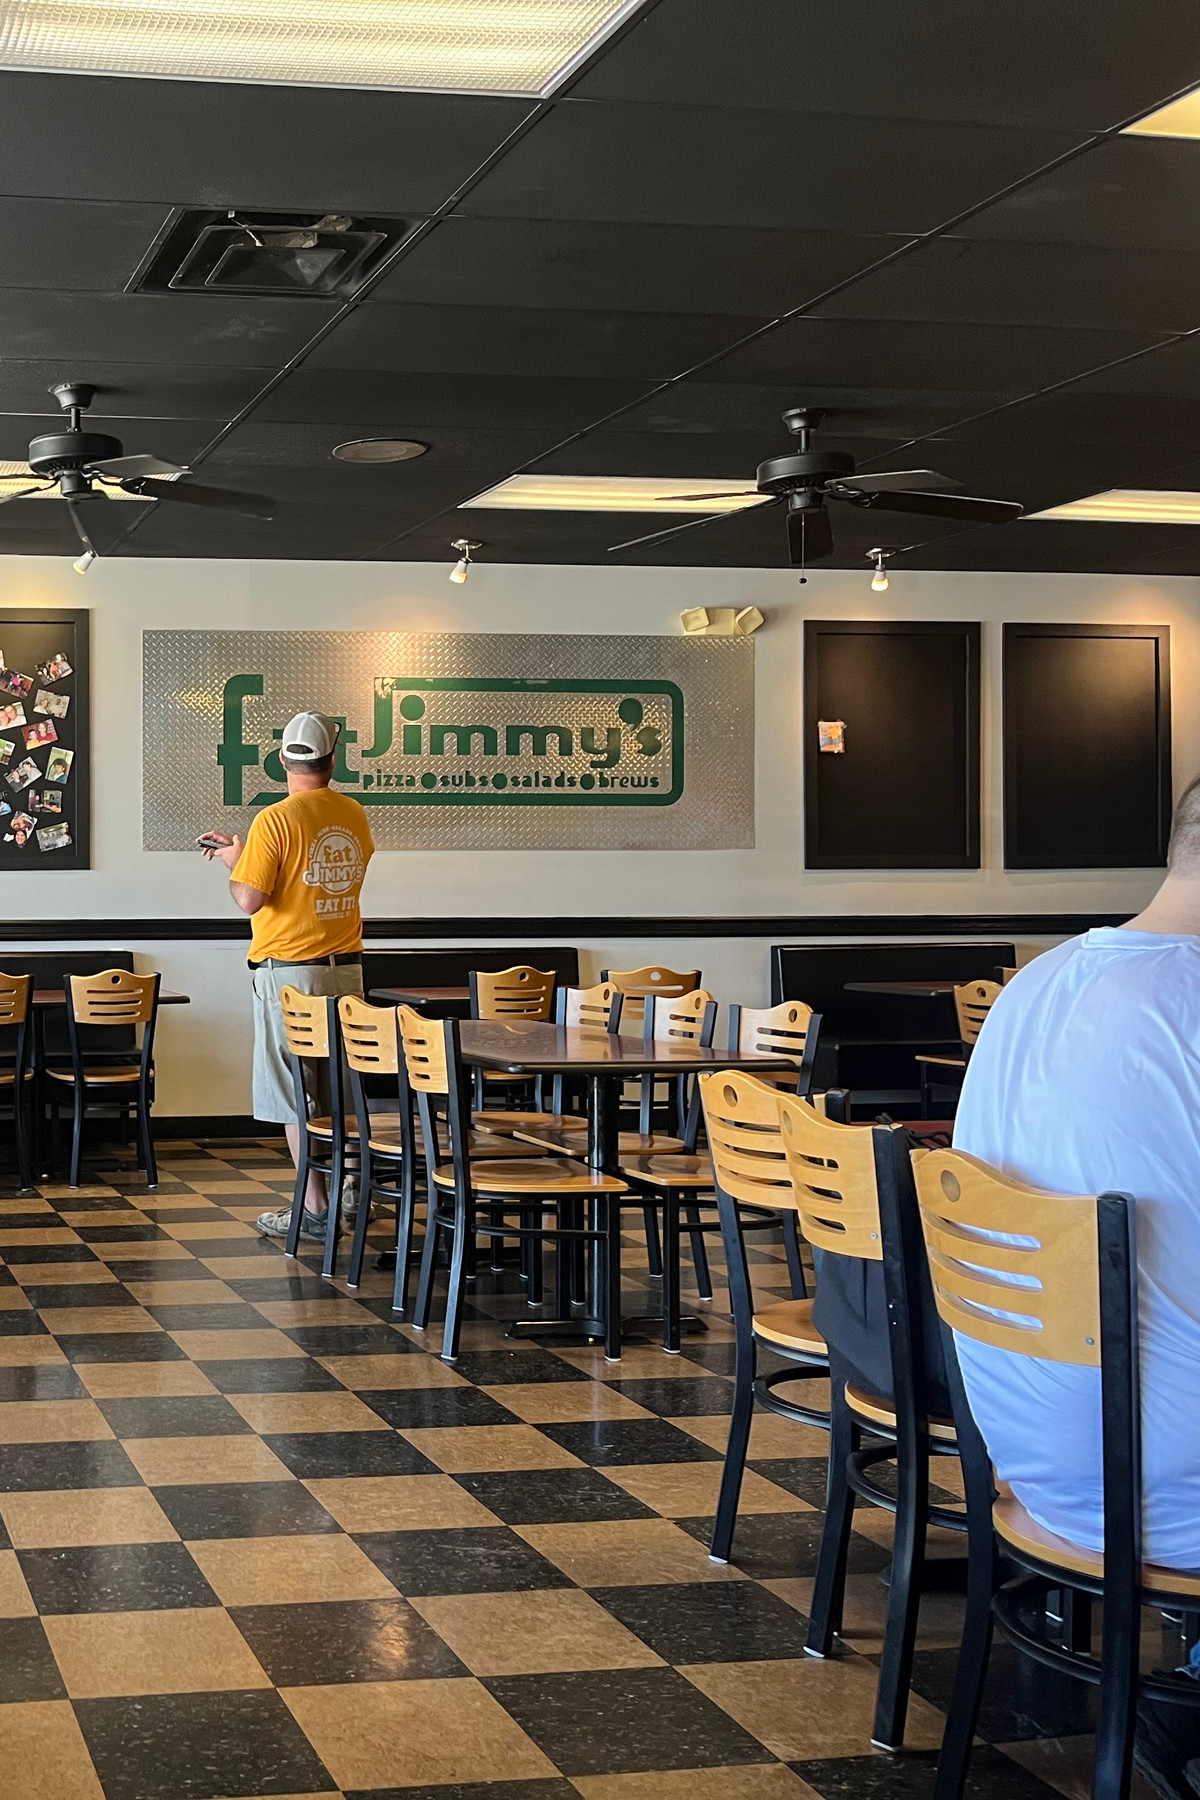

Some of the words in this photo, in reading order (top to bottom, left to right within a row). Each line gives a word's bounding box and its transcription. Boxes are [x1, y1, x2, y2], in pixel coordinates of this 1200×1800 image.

[217, 674, 360, 806] ft
[361, 677, 662, 768] Jimmy's
[363, 769, 416, 790] pizza
[439, 770, 489, 788] subs
[511, 771, 577, 789] salads
[600, 773, 660, 789] brews
[324, 845, 352, 863] fat
[315, 899, 339, 912] EAT
